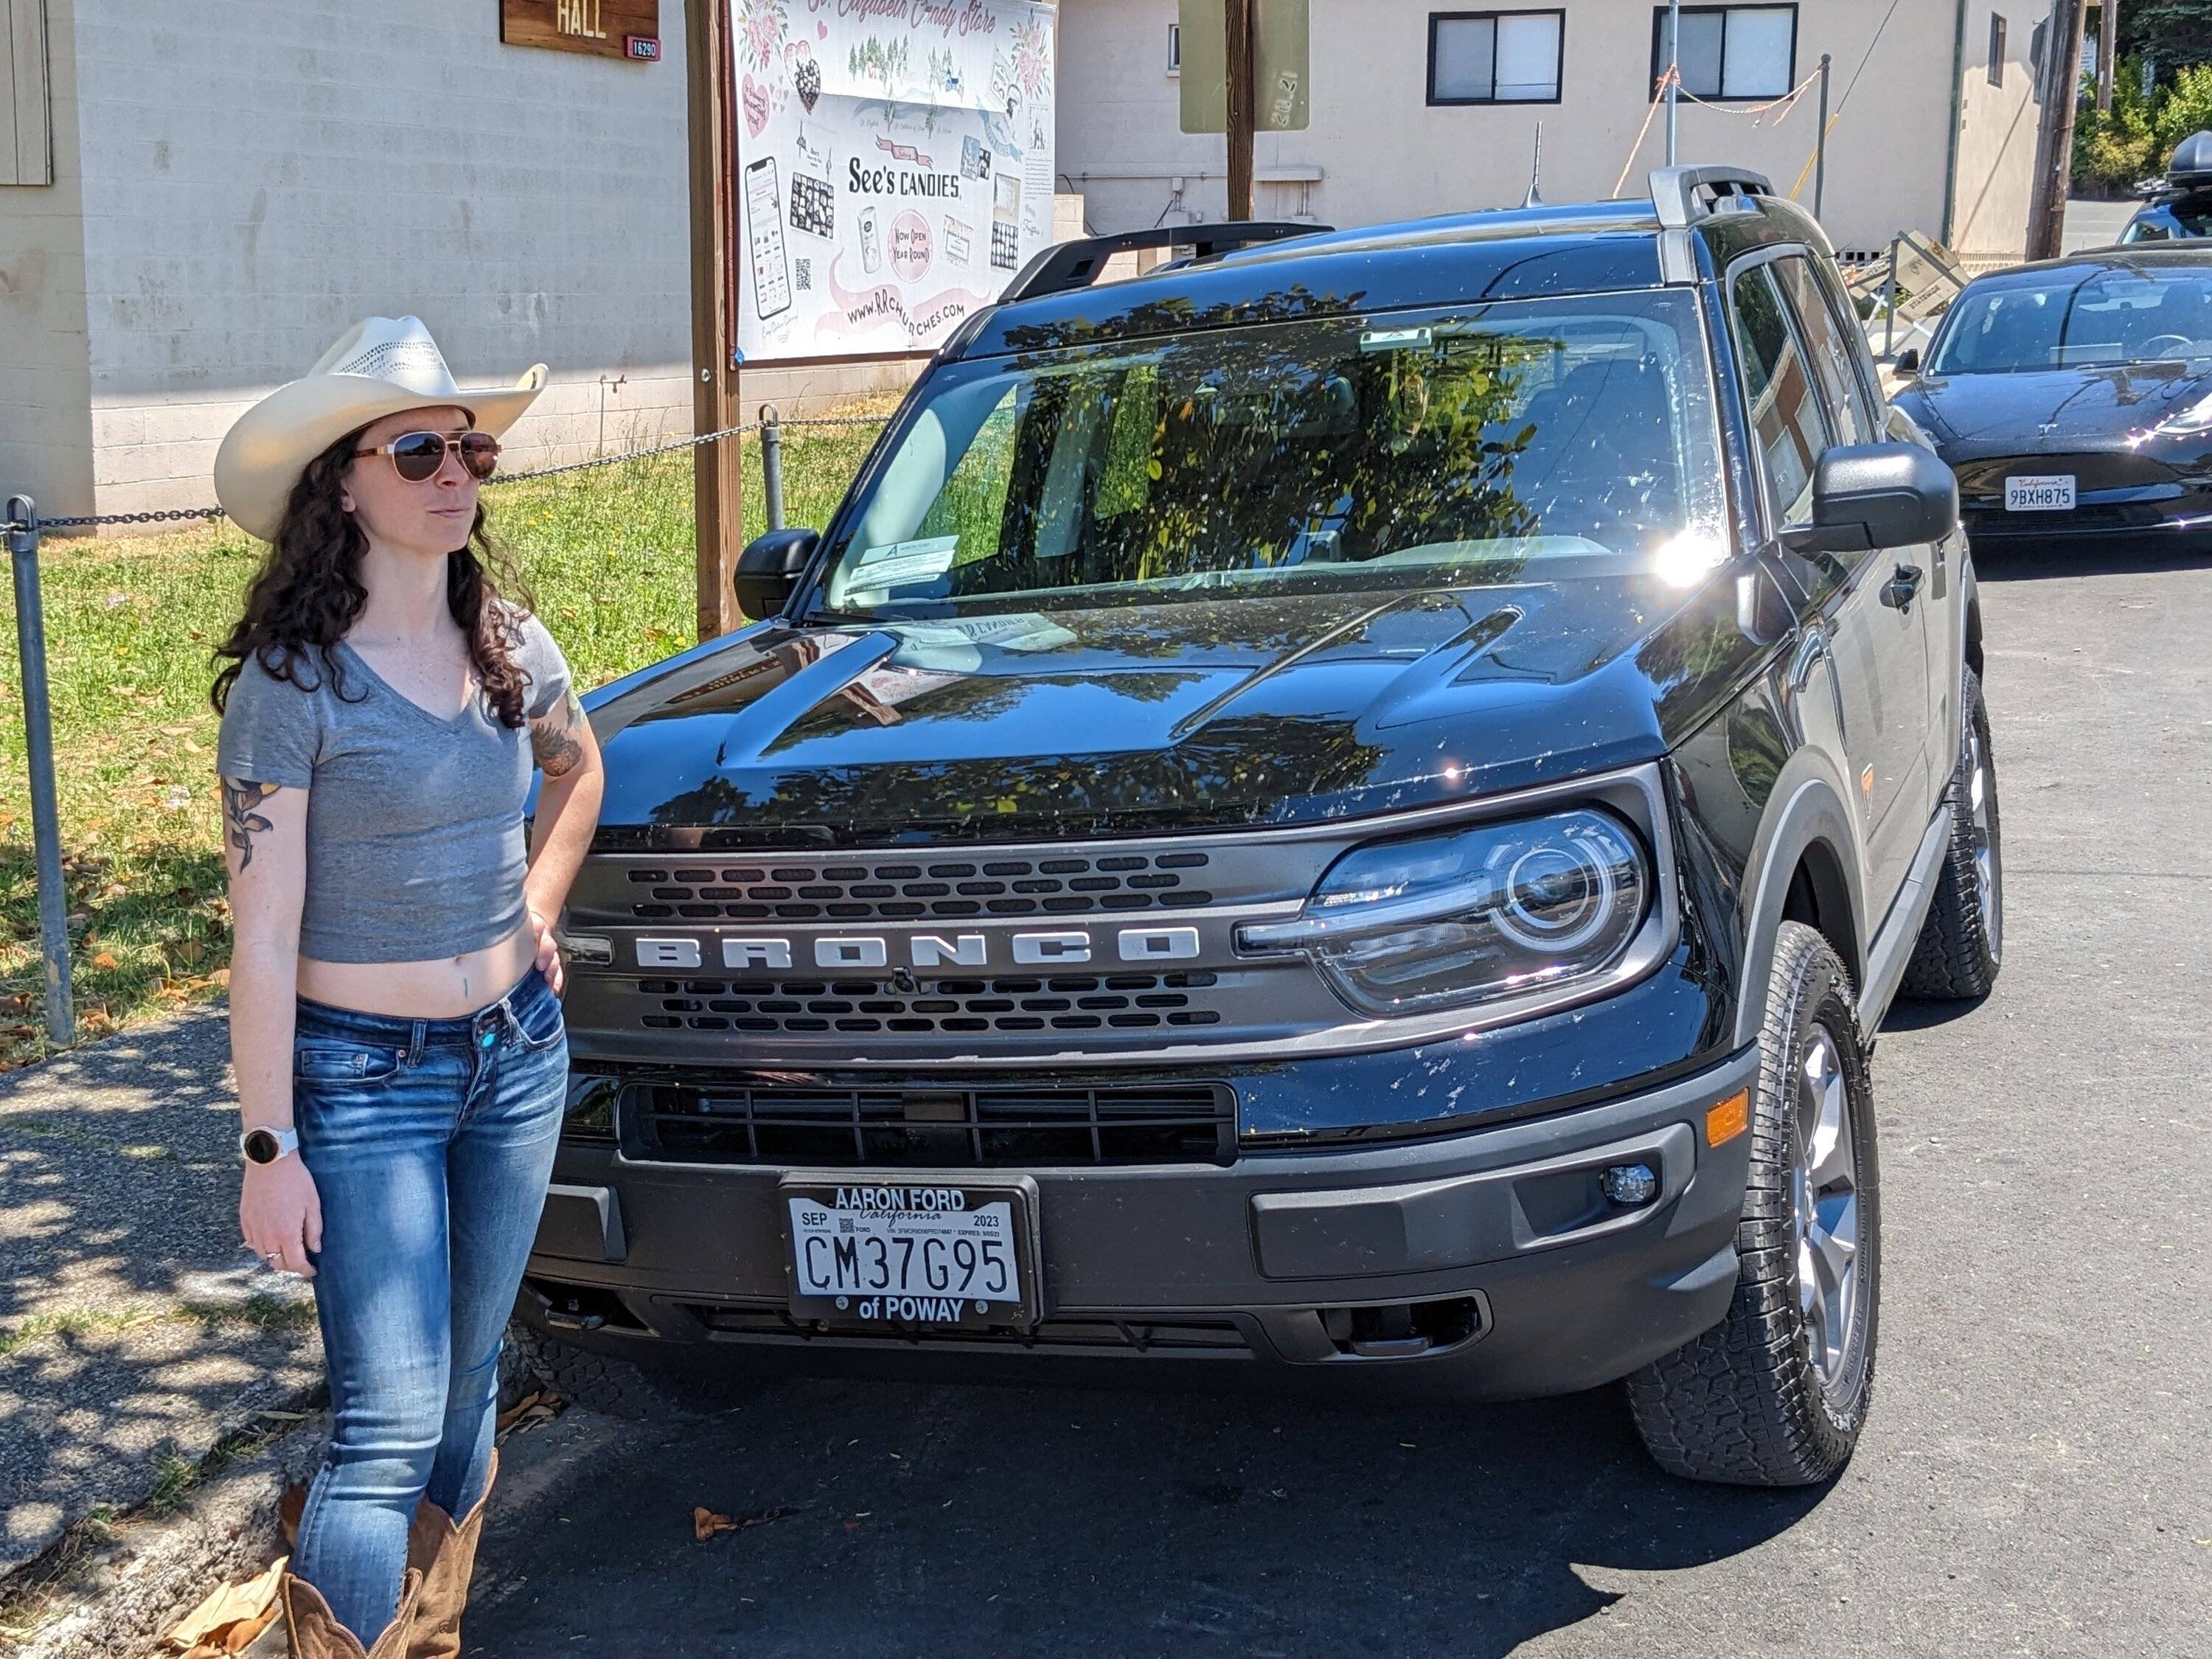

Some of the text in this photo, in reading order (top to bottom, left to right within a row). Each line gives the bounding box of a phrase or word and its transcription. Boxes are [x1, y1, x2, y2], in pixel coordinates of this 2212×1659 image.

[557, 0, 606, 38] HALL
[959, 0, 996, 37] Store
[633, 41, 655, 57] 16290
[849, 156, 895, 195] See's
[900, 171, 959, 198] CANDIES
[2010, 488, 2070, 505] 9BXH875
[635, 926, 1201, 970] BRONCO
[835, 1188, 966, 1211] AARON FORD
[801, 1212, 827, 1226] SEP
[860, 1208, 943, 1228] California
[973, 1215, 999, 1228] 2023
[804, 1236, 1008, 1293] CM37G95
[859, 1298, 964, 1322] of POWAY
